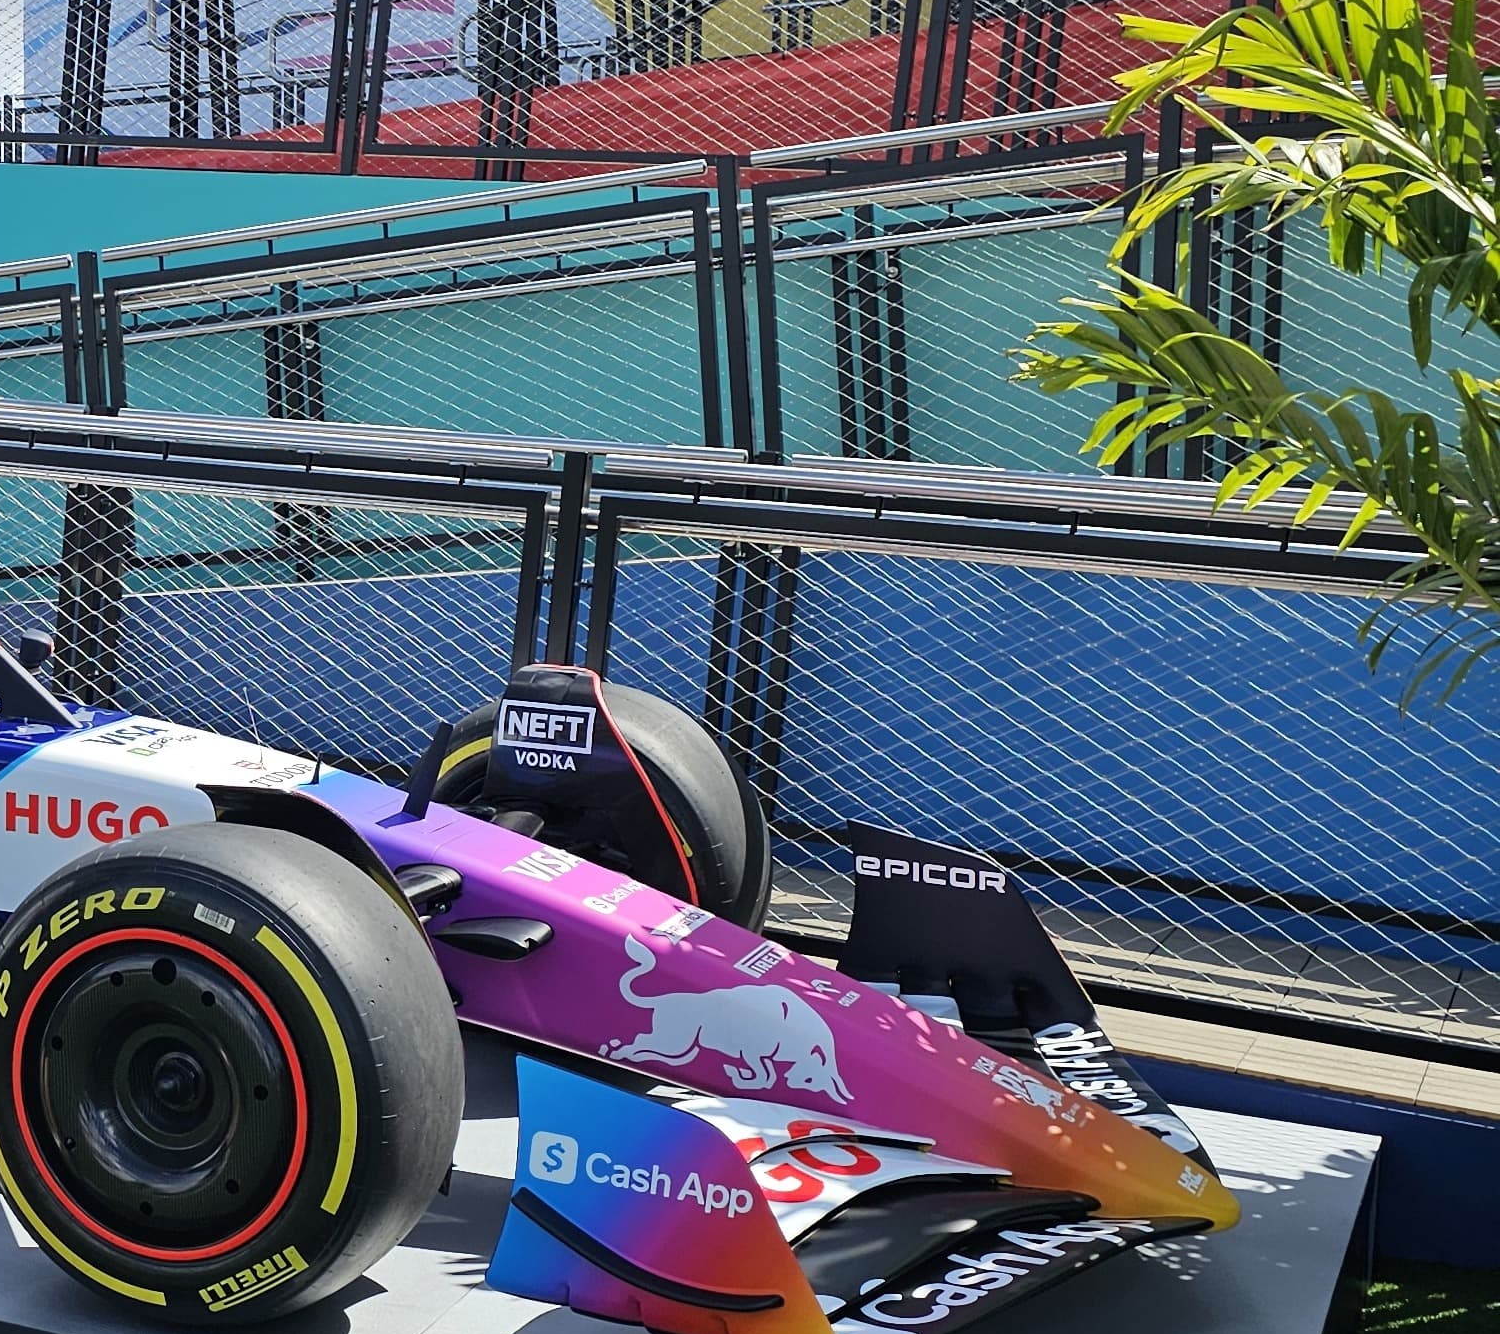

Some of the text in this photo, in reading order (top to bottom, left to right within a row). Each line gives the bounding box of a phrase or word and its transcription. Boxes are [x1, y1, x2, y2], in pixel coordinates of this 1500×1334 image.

[81, 724, 171, 748] VISA
[507, 710, 585, 742] NEFT
[250, 763, 314, 788] TUDOR
[515, 750, 577, 772] VODKA
[4, 790, 170, 844] HUGO
[501, 845, 587, 883] VISA
[19, 887, 167, 971] ZERO
[585, 1152, 671, 1198] Cash
[677, 1171, 754, 1219] App
[198, 1245, 309, 1313] PIRELLI
[860, 1253, 1050, 1325] Cash
